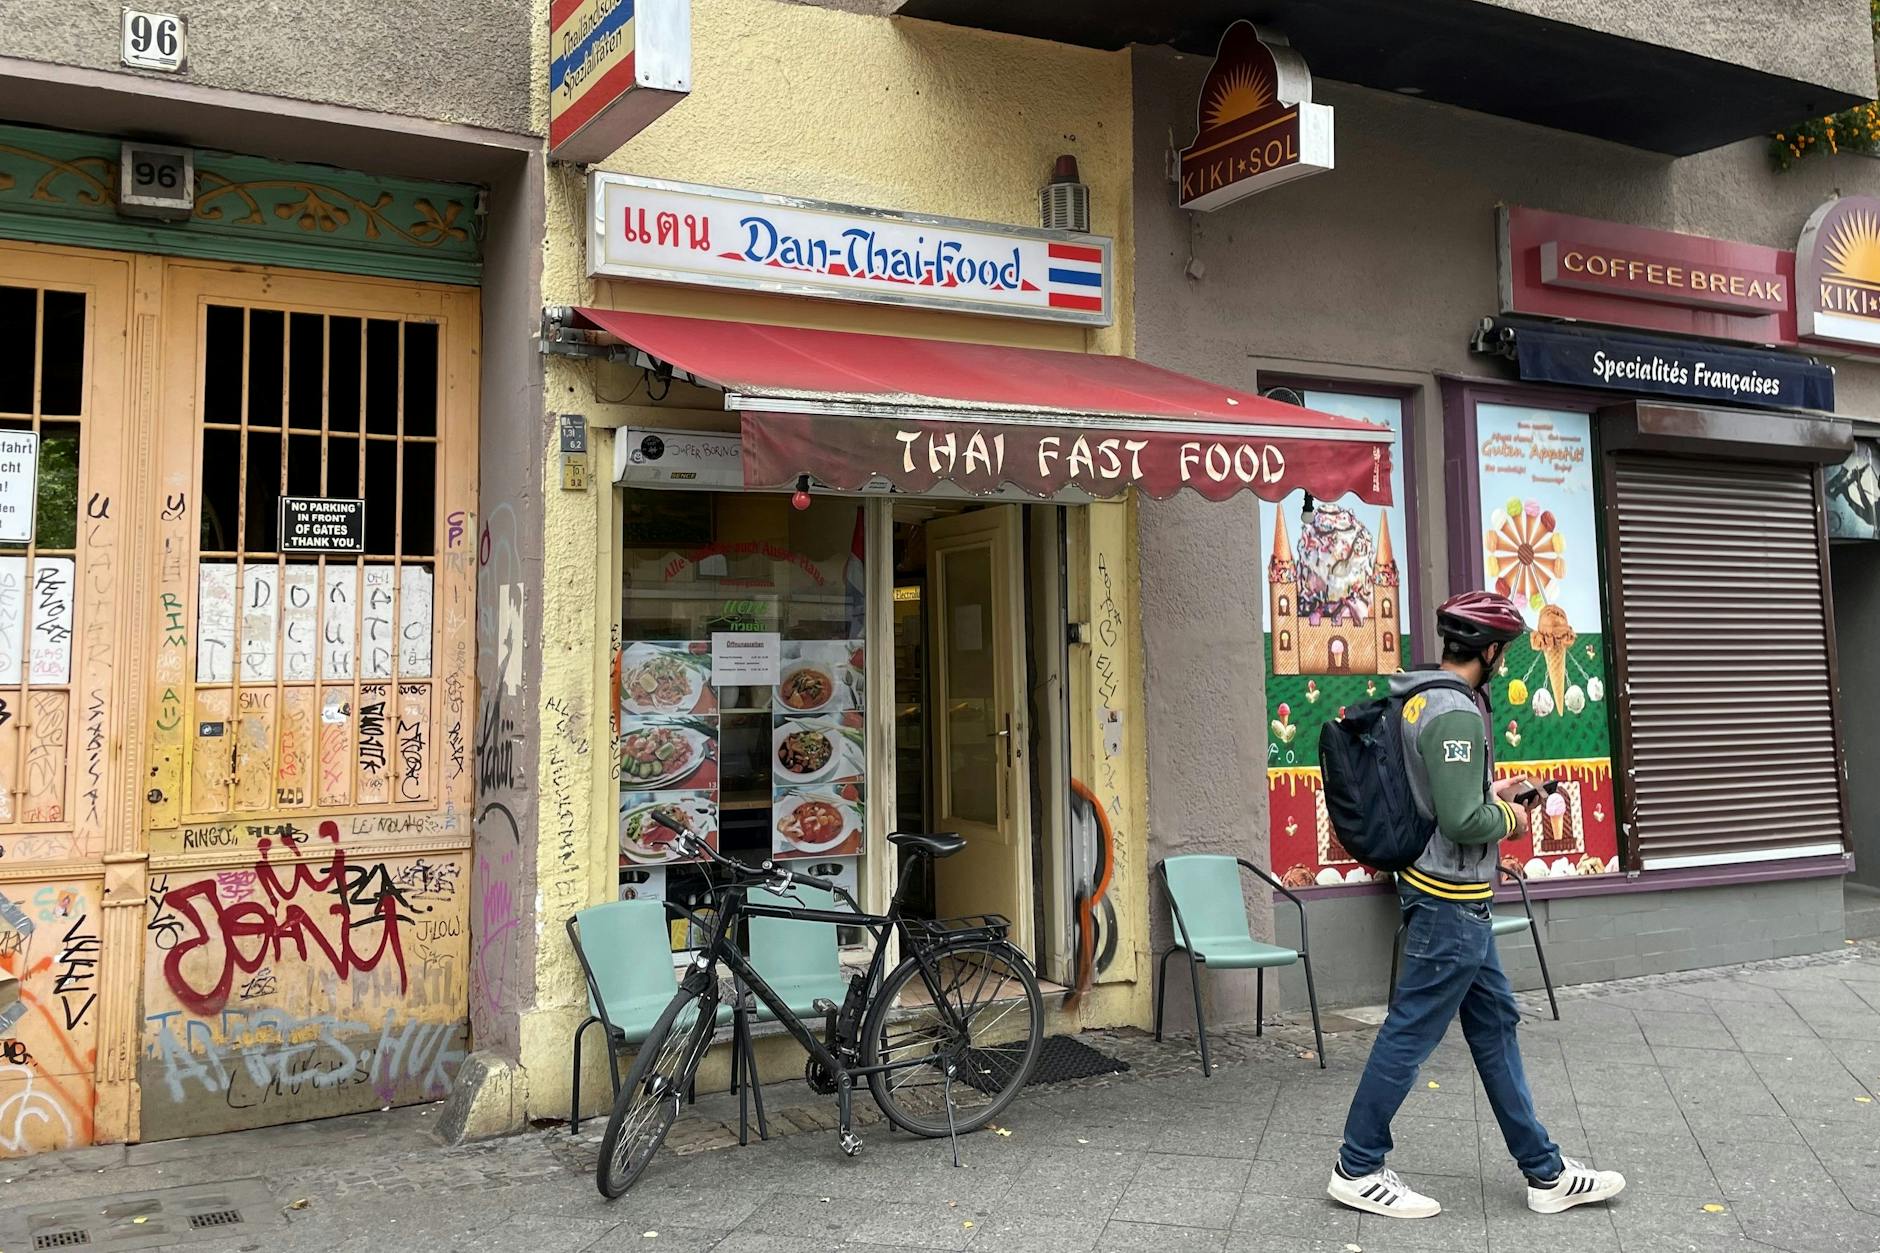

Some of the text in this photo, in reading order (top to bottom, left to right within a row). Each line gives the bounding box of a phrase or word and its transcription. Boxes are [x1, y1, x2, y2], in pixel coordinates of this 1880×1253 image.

[130, 15, 179, 56] 96
[563, 28, 622, 100] Spezialitäten
[134, 162, 179, 190] 96
[1182, 134, 1298, 200] KIKI SOL
[624, 206, 711, 252] แตน
[739, 216, 1020, 290] Dan-Thai-Food
[1564, 251, 1783, 302] COFFEE BREAK
[1820, 283, 1867, 314] KIKI
[1592, 350, 1780, 397] Specialités Françaises
[895, 428, 1286, 484] THAI FAST FOOD
[291, 502, 356, 513] NO PARKING
[297, 513, 347, 523] IN FRONT
[290, 536, 355, 548] THANK YOU
[295, 523, 348, 536] OF GATES
